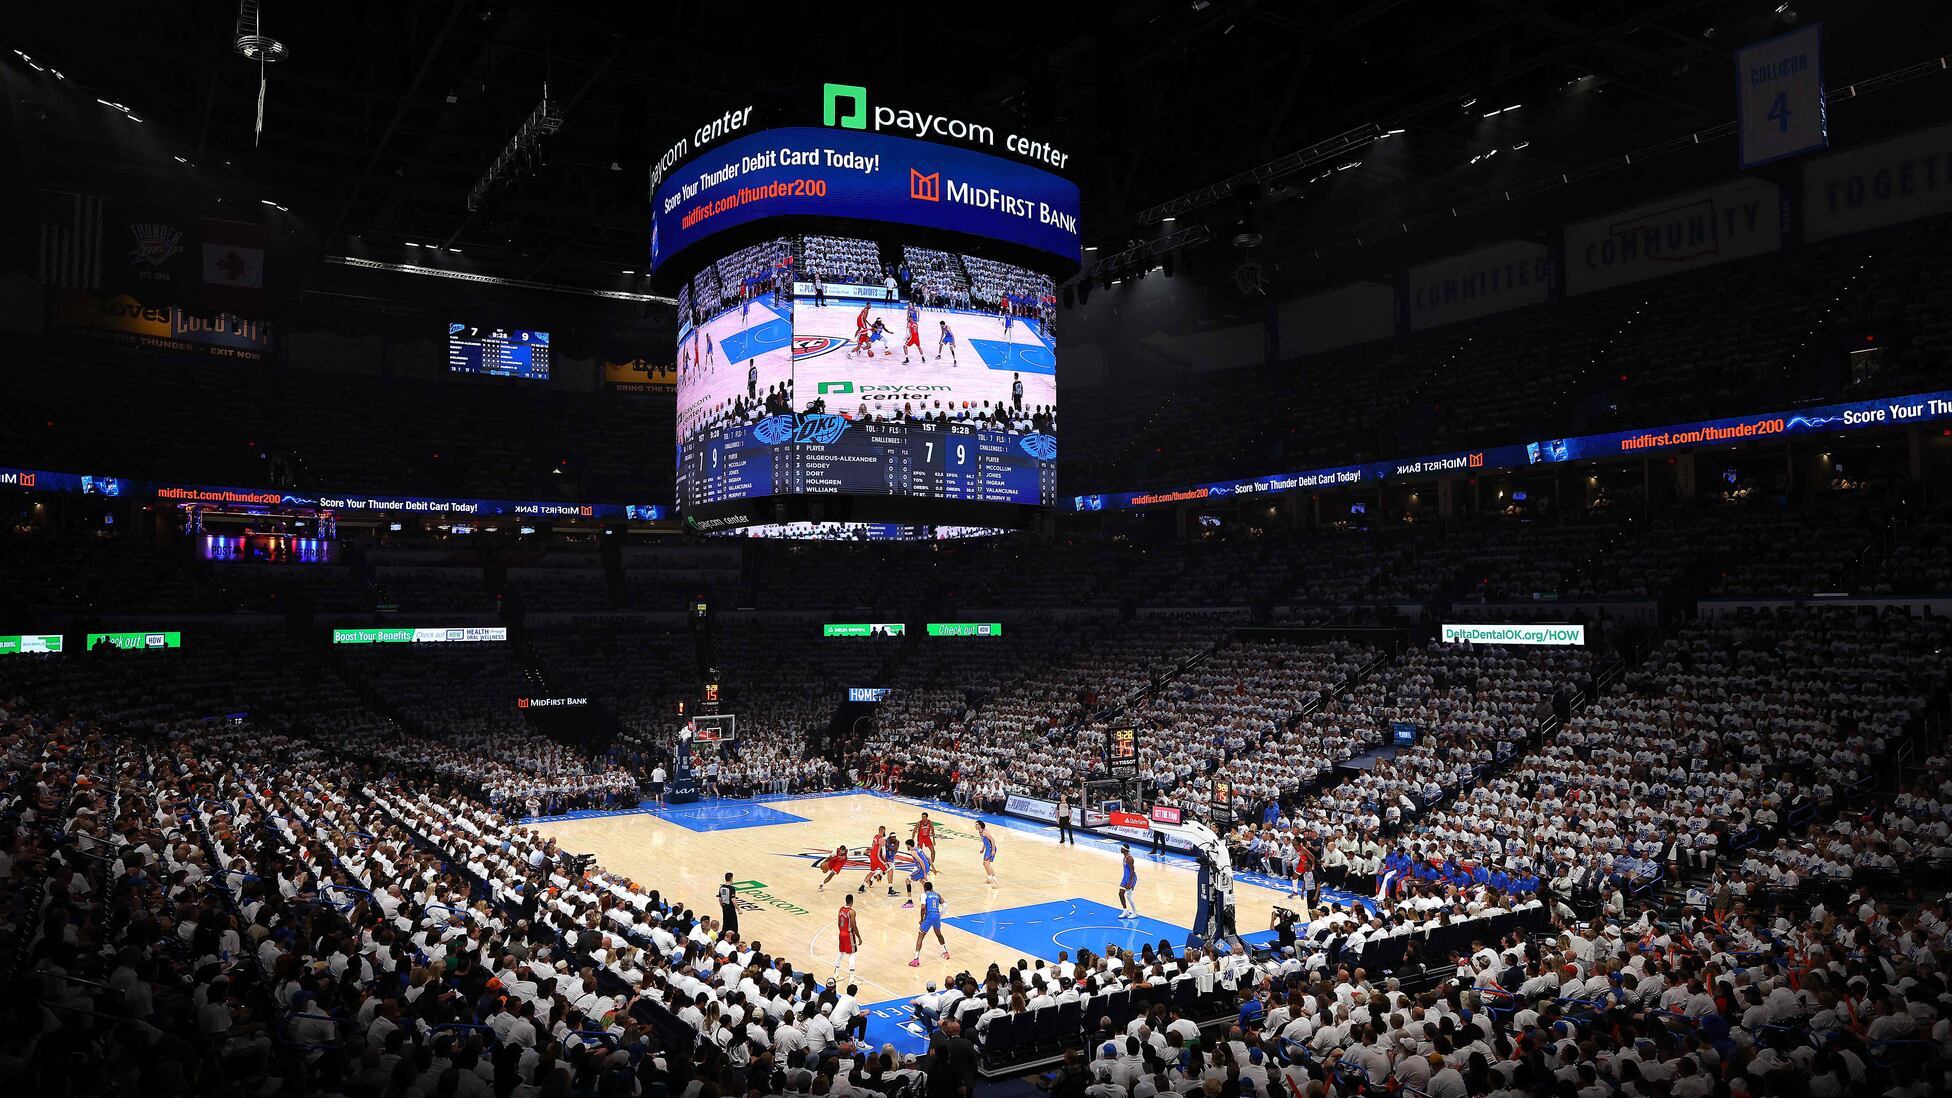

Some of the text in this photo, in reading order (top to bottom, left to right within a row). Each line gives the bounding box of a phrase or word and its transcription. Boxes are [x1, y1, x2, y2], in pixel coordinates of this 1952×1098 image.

[1767, 91, 1792, 133] 4
[695, 106, 752, 147] center
[875, 106, 1068, 169] paycom center
[665, 148, 879, 214] Score Your Thunder Debit Card Today!
[682, 180, 826, 230] midfirst.com/thunder200
[1585, 202, 1759, 270] COMMUNITY
[858, 288, 878, 296] PLAYOFFS
[1415, 257, 1547, 311] COMMITTED
[471, 328, 478, 336] 7
[140, 336, 193, 351] THUNDER
[210, 348, 234, 358] EXIT
[237, 350, 262, 361] NOW
[860, 384, 951, 393] paycom
[1844, 411, 1885, 424] Score
[1889, 405, 1923, 419] Your
[952, 426, 969, 434] 9:28
[1622, 419, 1784, 450] midfirst.com/thunder200
[713, 448, 717, 468] 9
[926, 442, 933, 462] 7
[957, 445, 965, 464] 9
[1235, 470, 1361, 493] Score Your Thunder Debit Card Today!
[158, 487, 281, 504] midfirst.com/thunder200
[986, 487, 1018, 495] VALANCIUNAS
[1132, 488, 1208, 504] midfirst.com/thunder200
[320, 498, 478, 513] Score Your Thunder Debit Card Today!
[336, 631, 410, 641] Boost Your Benefits
[939, 625, 975, 635] Check out
[1447, 629, 1579, 642] DeltaDentalOK.org/HOW
[125, 636, 141, 647] out
[708, 691, 717, 700] 15
[1117, 731, 1132, 740] 9:28
[1012, 799, 1030, 812] PLAYOFFS
[737, 890, 809, 915] paycom
[933, 900, 936, 908] 8
